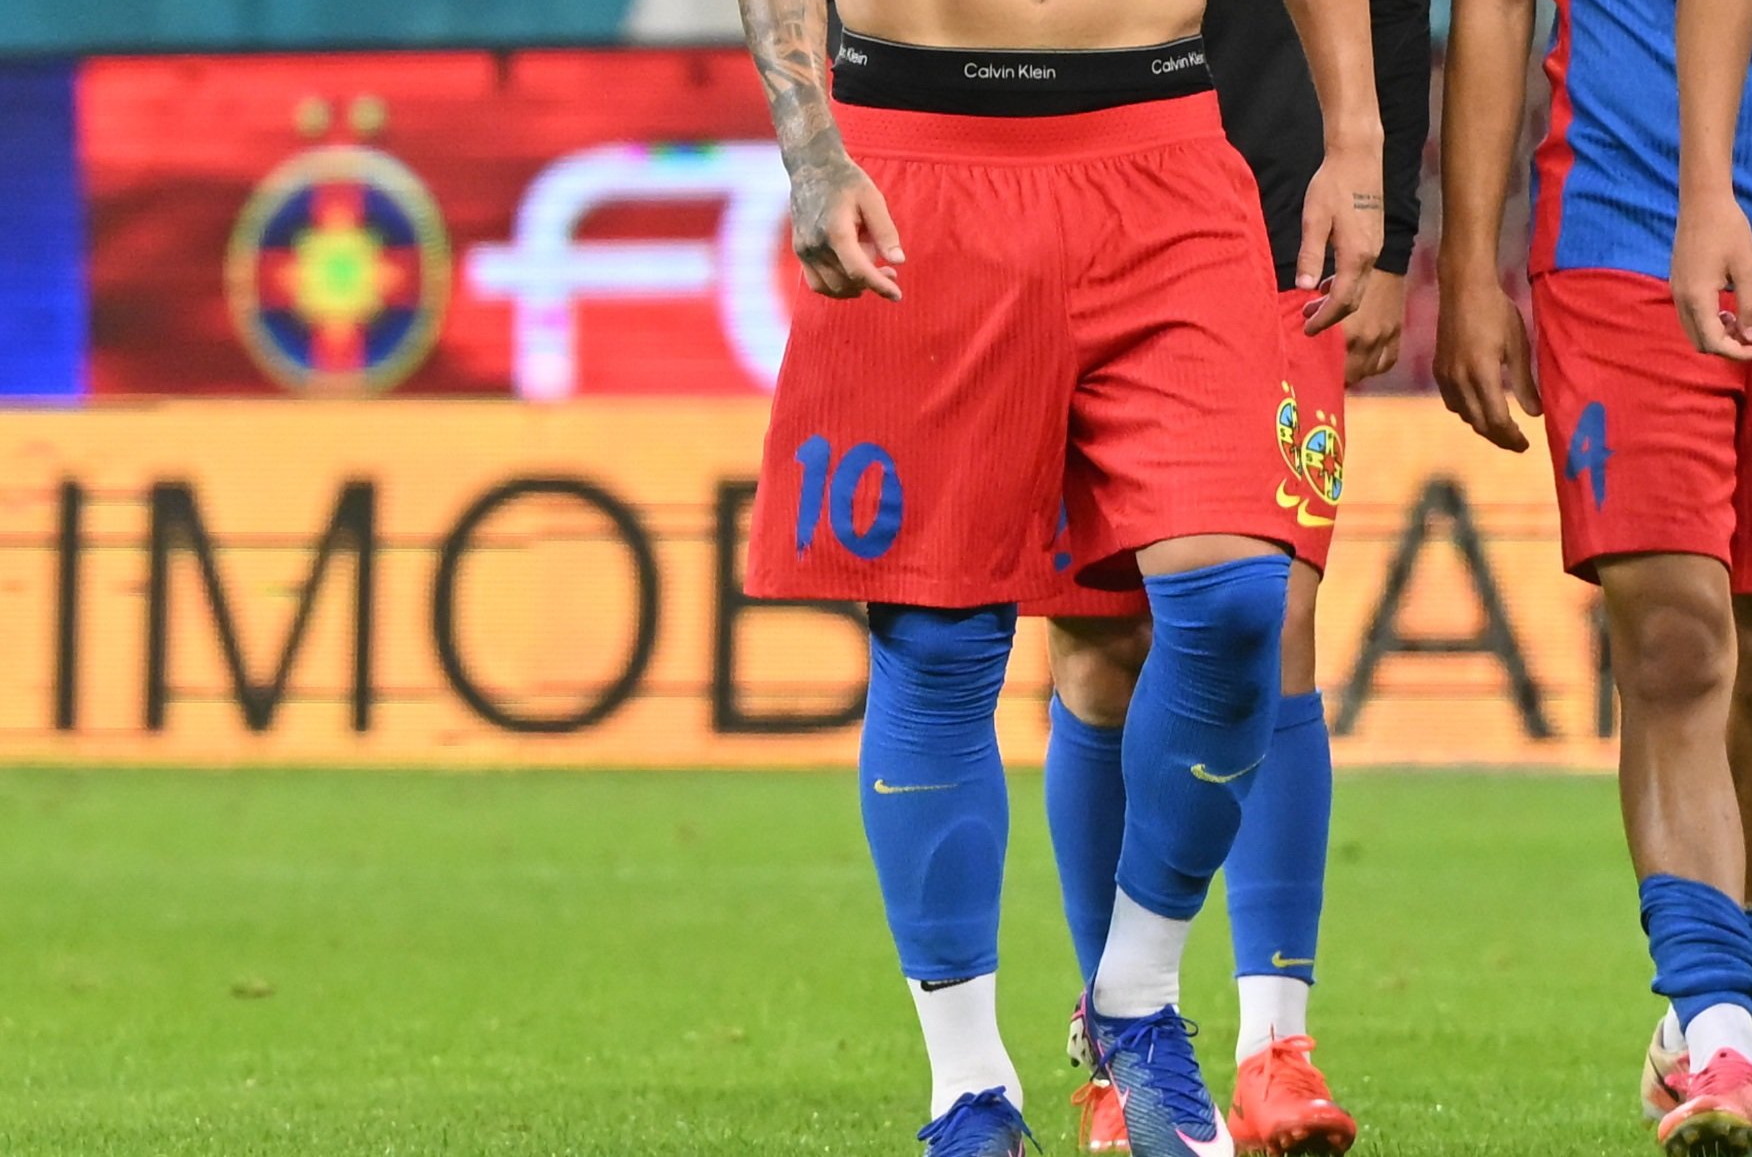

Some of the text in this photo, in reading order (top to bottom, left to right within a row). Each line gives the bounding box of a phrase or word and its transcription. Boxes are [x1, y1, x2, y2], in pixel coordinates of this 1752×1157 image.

[963, 62, 1057, 79] Calvin Klein
[1151, 54, 1189, 75] Calvin
[1564, 401, 1616, 512] 4
[795, 434, 904, 560] 10
